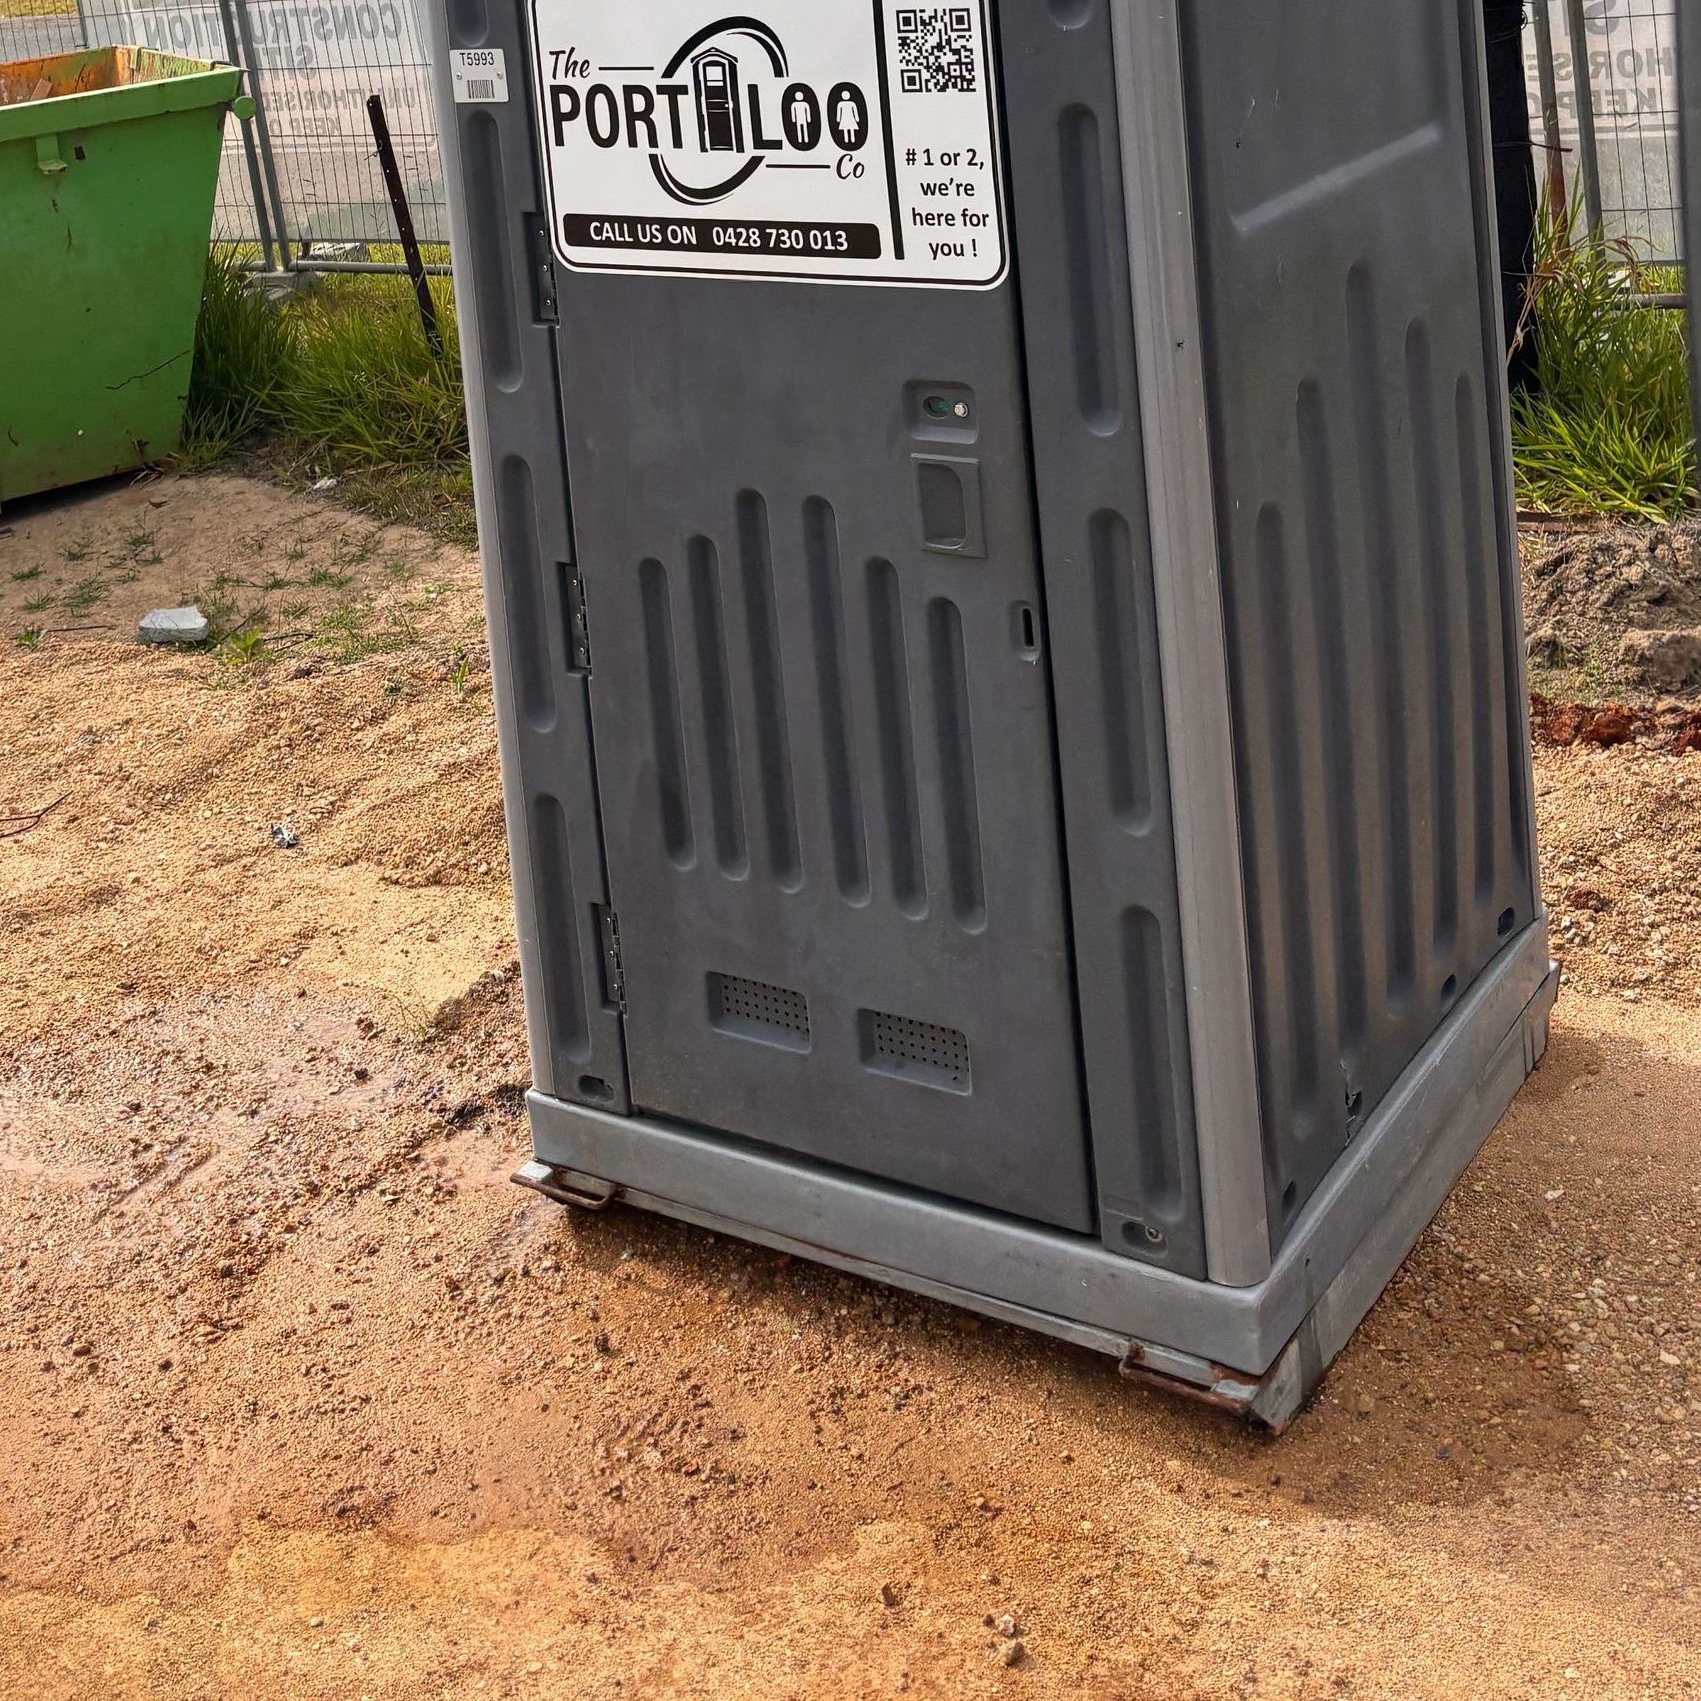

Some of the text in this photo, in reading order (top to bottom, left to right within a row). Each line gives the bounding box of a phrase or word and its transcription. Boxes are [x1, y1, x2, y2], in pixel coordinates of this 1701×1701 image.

[459, 51, 495, 66] T5993
[549, 47, 591, 80] The
[836, 154, 866, 180] Co
[905, 148, 984, 170] # 1 or 2,
[911, 206, 990, 227] here for
[589, 221, 849, 251] CALL US ON 0428 730 013
[928, 242, 965, 260] you
